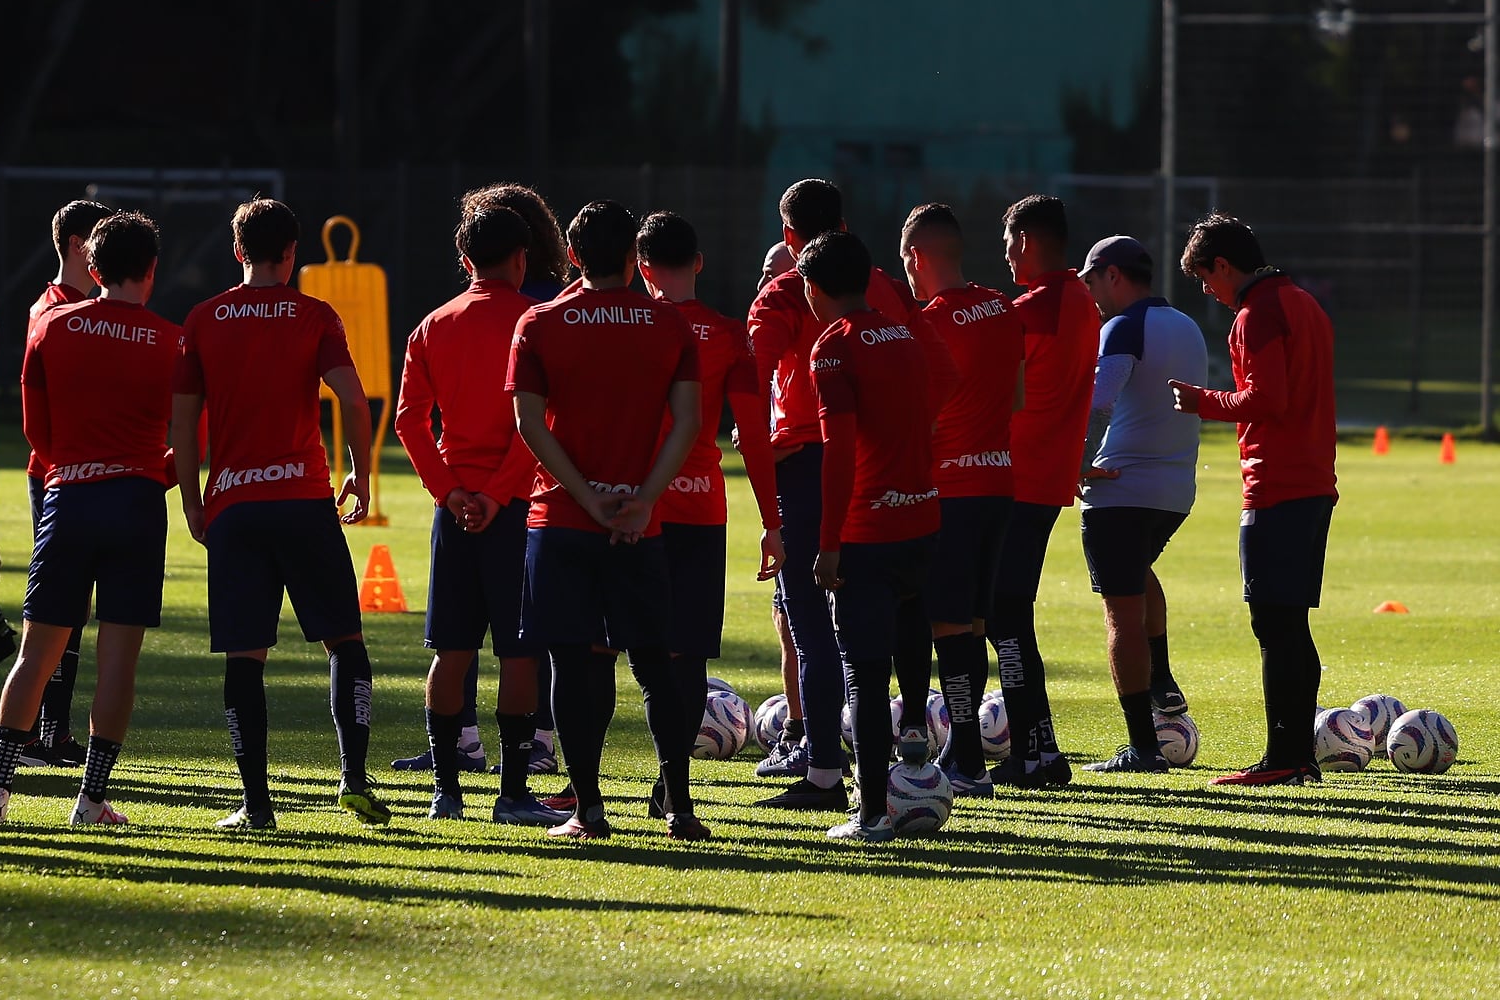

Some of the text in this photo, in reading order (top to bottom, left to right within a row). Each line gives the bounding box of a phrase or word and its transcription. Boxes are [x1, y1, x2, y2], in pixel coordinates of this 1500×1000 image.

[215, 302, 297, 321] OMNILIFE
[564, 306, 654, 325] OMNILIFE
[952, 299, 1007, 326] OMNILIFE
[67, 316, 157, 345] OMNILIFE
[211, 462, 305, 496] AKRON
[998, 637, 1025, 689] PERDURA
[945, 673, 974, 724] PERDURA
